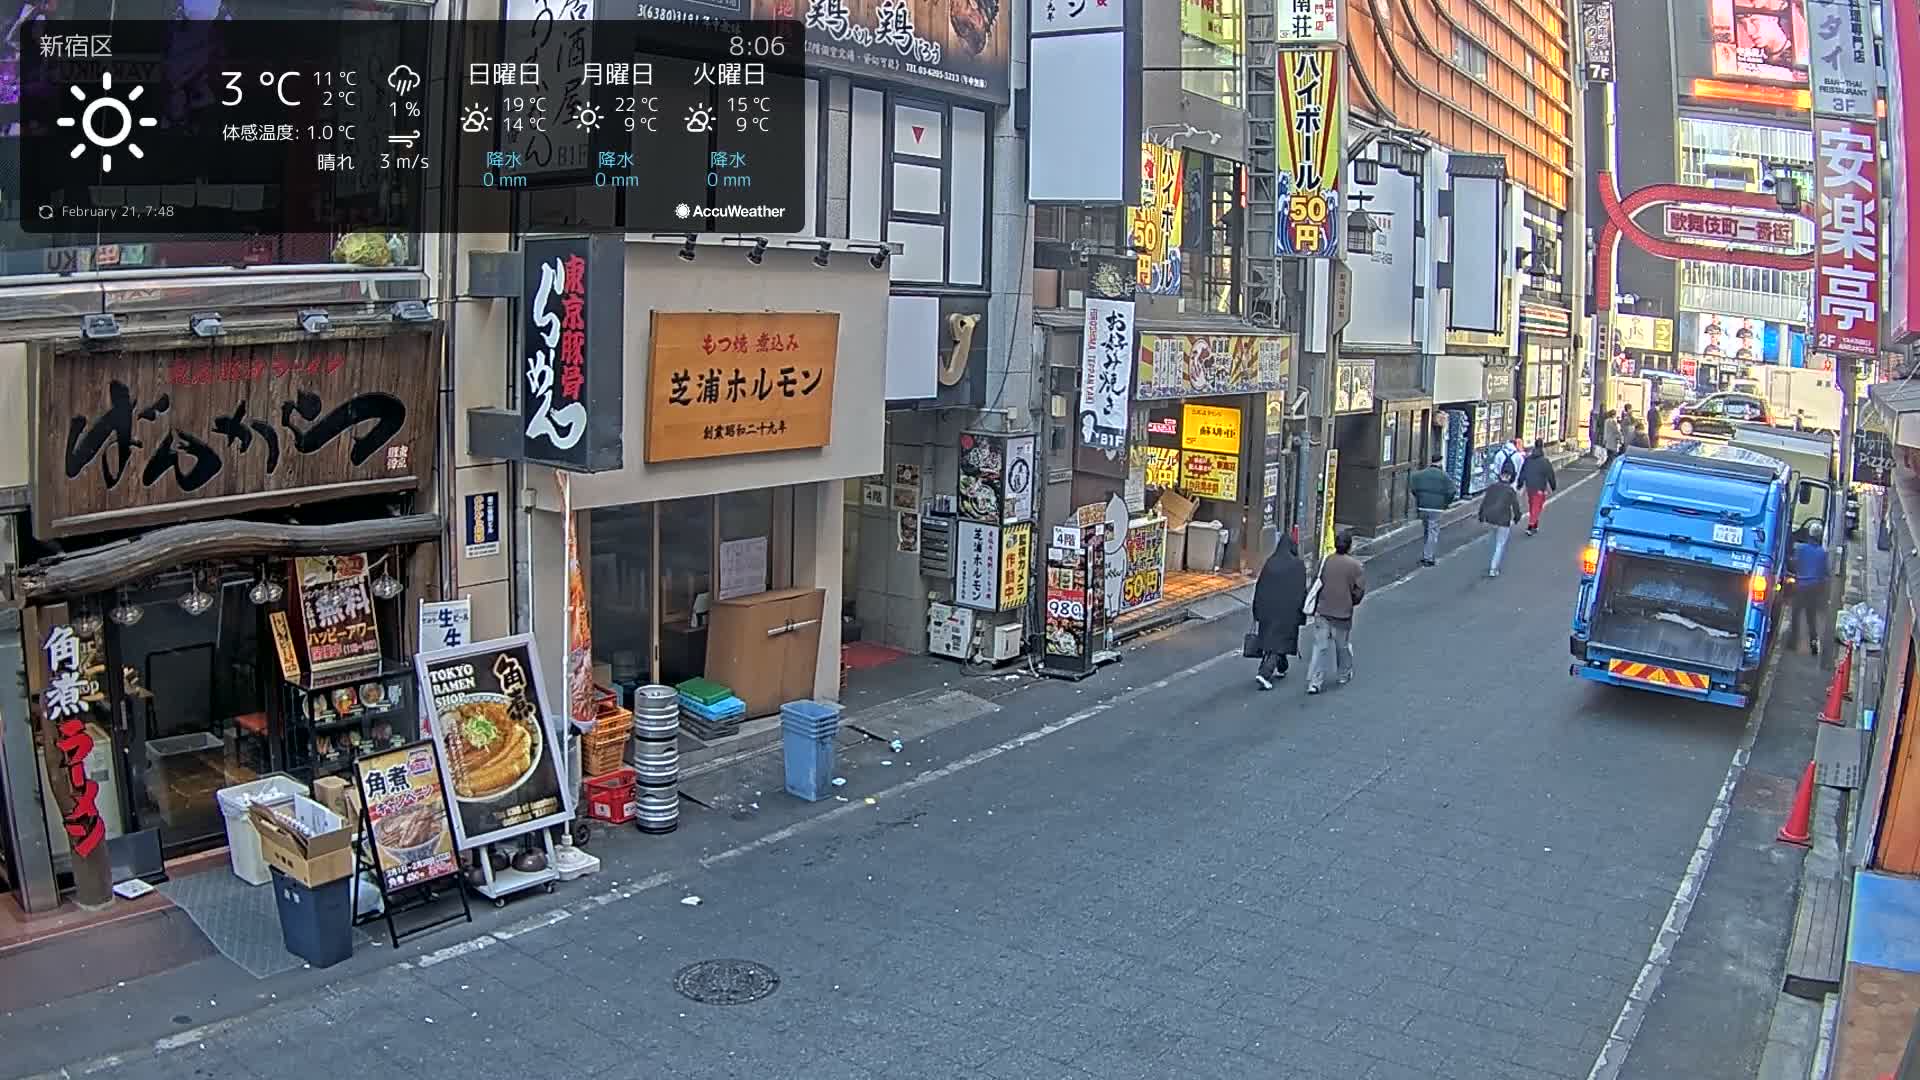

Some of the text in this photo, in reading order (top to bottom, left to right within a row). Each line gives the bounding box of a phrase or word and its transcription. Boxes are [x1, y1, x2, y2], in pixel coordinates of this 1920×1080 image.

[1590, 64, 1610, 79] 7F
[1294, 53, 1322, 191] ハイボール
[1833, 98, 1857, 112] 3F
[1161, 154, 1175, 288] ハイボール
[1670, 212, 1792, 243] 歌舞伎町一番街
[1821, 127, 1877, 332] 安楽亭
[561, 253, 586, 401] 東京豚骨
[702, 332, 800, 355] もつ焼 煮込み
[1818, 333, 1837, 347] 2F
[1099, 310, 1128, 416] お好み焼き
[668, 366, 823, 406] 芝浦ホルモン
[65, 379, 407, 492] ばんから
[703, 420, 787, 440] 創業昭和二十九年
[1100, 432, 1125, 448] B1F
[971, 527, 983, 601] 芝浦ホルモン
[308, 622, 377, 646] ハッピーアワー
[43, 624, 90, 720] 角煮
[429, 664, 475, 684] TOKYO
[433, 677, 477, 696] RAMEN
[493, 653, 536, 721] 角煮
[435, 693, 466, 709] SHOP
[56, 719, 106, 858] ラーメン
[365, 763, 411, 799] 角煮
